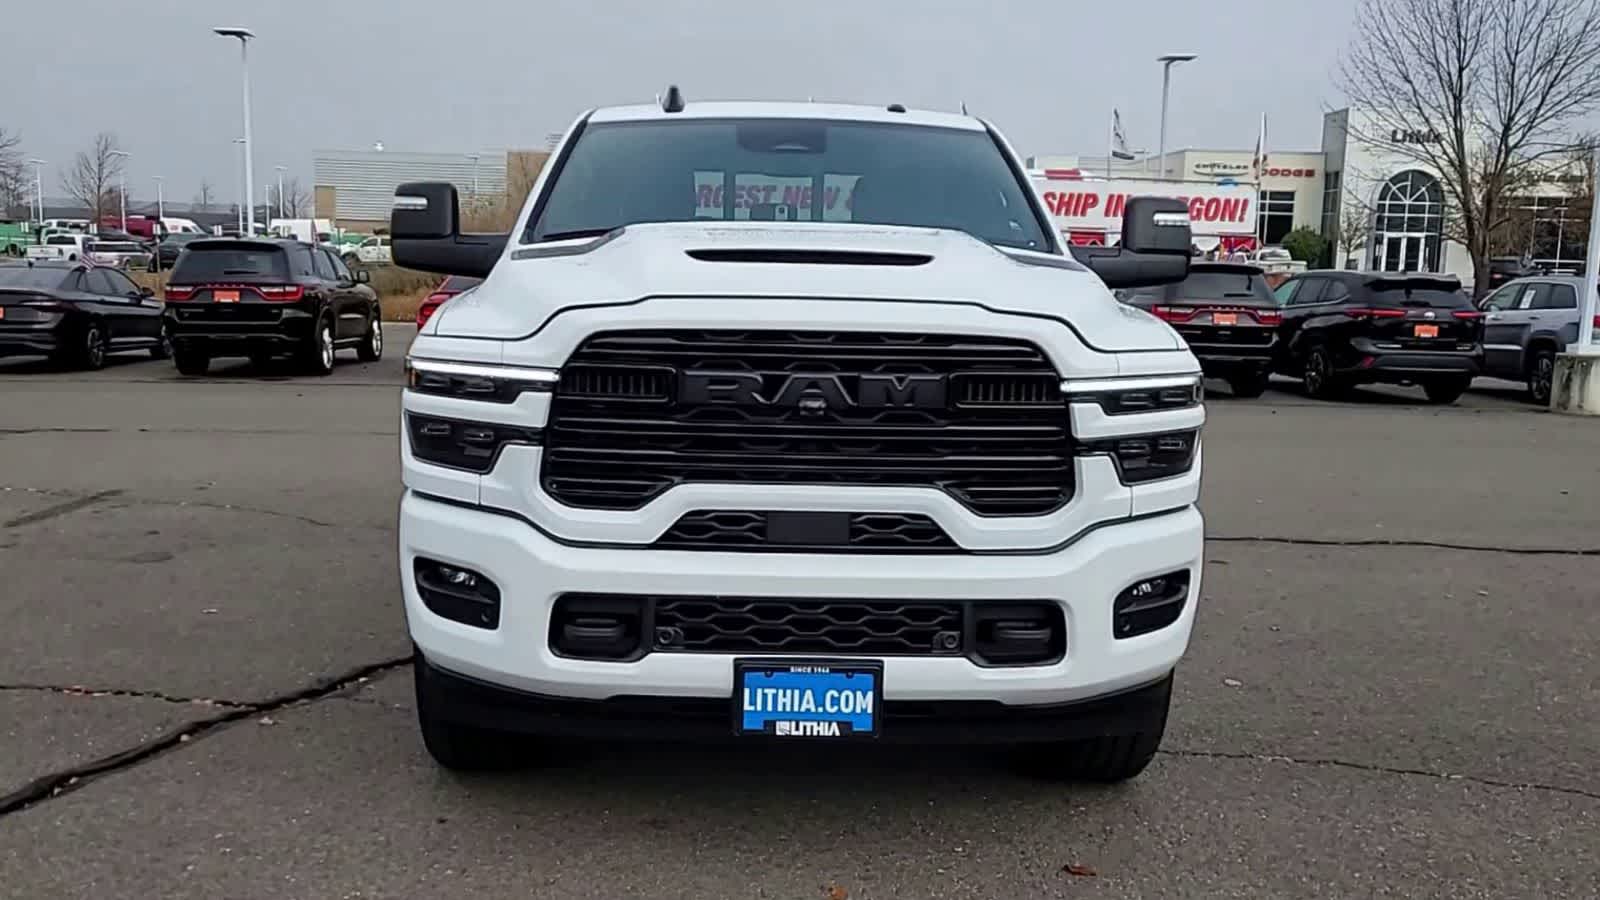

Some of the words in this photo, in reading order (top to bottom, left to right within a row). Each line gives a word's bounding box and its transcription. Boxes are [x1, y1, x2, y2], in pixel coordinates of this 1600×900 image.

[1043, 192, 1099, 217] SHIP
[684, 371, 946, 409] RAM
[743, 688, 874, 714] LITHIA.COM
[790, 721, 841, 736] LITHIA
